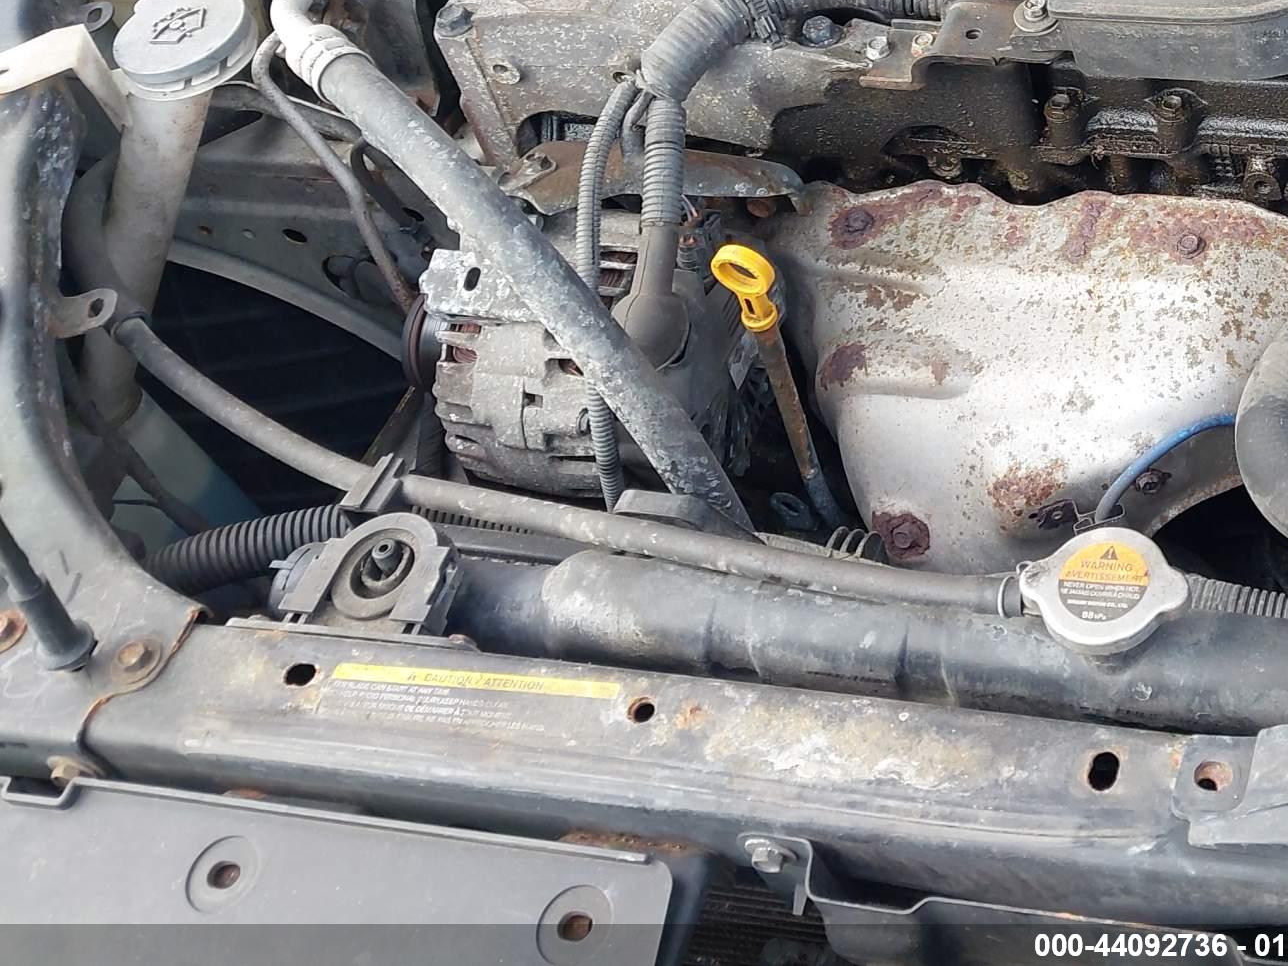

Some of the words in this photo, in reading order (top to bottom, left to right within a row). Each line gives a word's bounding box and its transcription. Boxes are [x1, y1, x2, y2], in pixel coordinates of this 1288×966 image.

[1081, 560, 1134, 572] WARNING
[424, 672, 474, 686] CAUTION
[484, 677, 545, 691] ATTENTION
